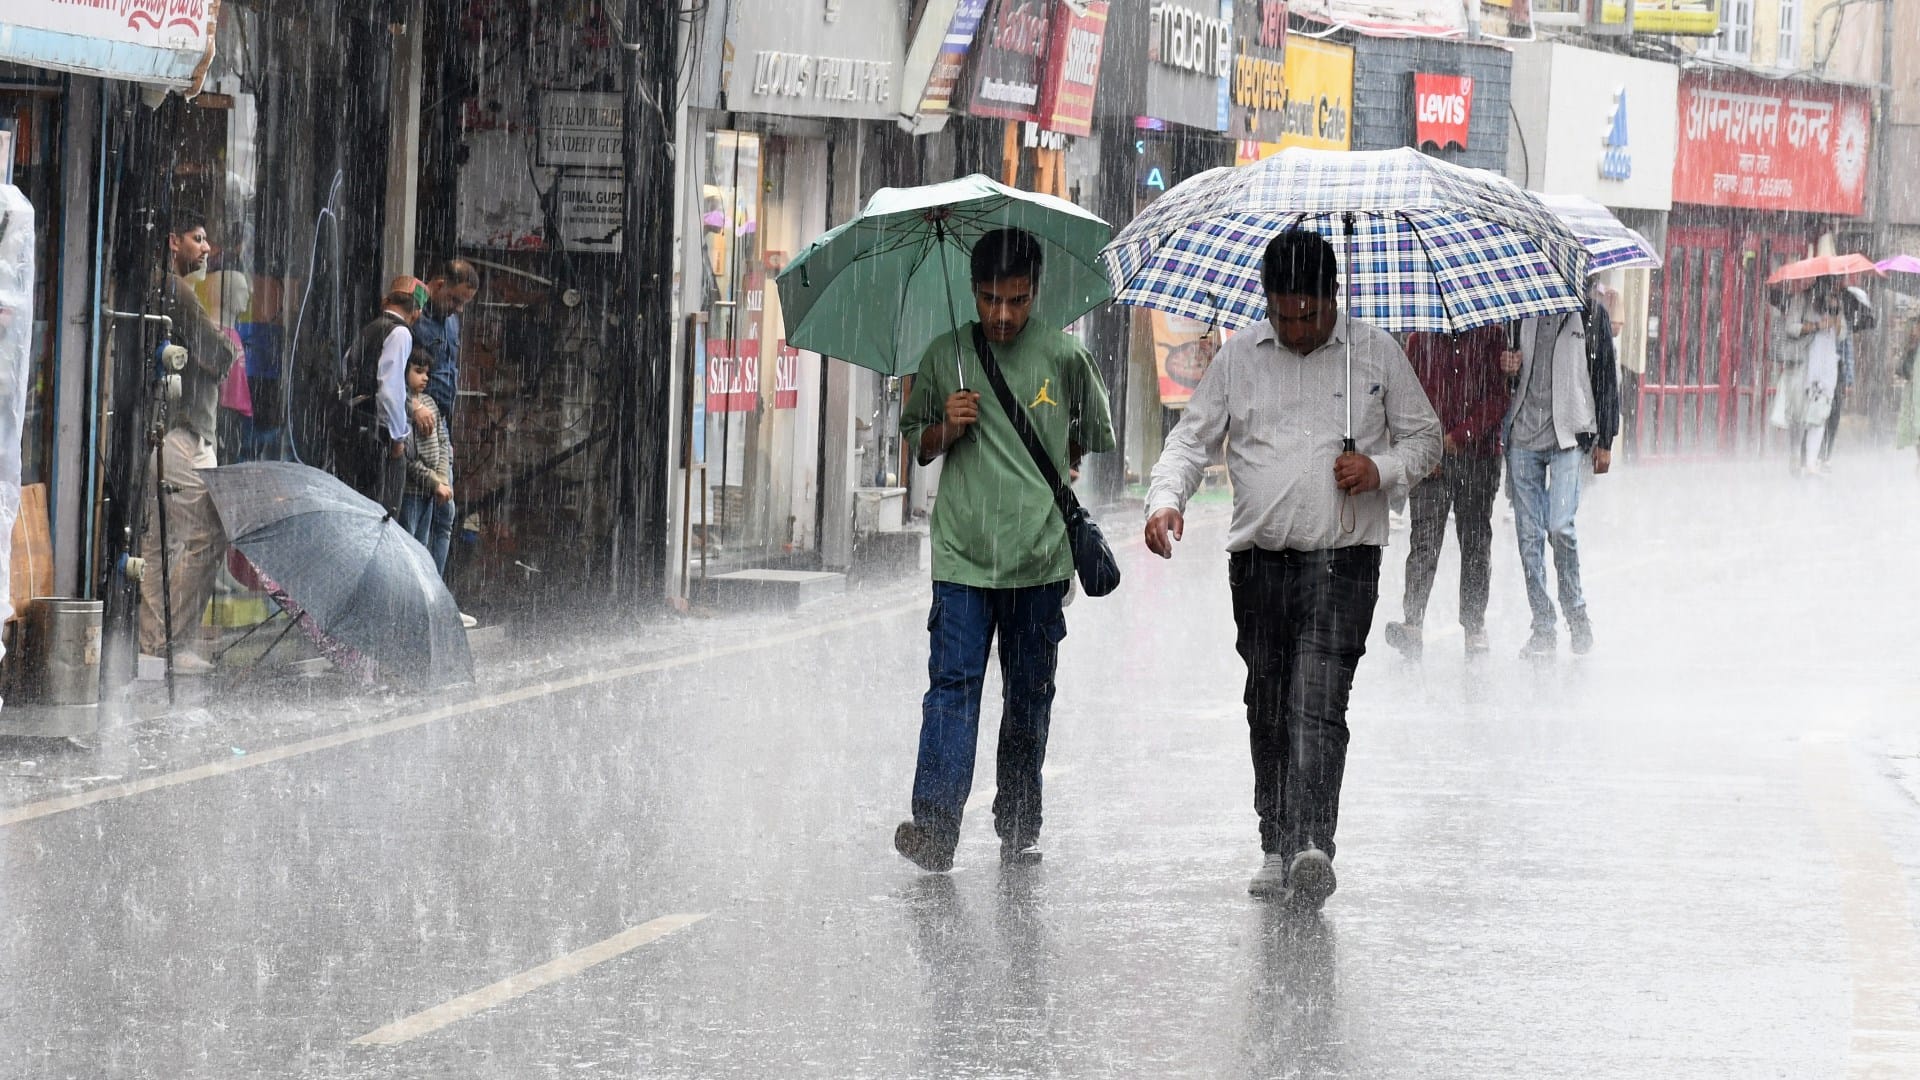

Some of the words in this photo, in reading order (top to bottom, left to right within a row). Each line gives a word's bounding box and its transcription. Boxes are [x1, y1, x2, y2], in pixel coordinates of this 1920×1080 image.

[753, 50, 811, 97] LOUIS
[814, 56, 892, 103] PHILIPPE
[547, 135, 595, 152] SANDEEP
[561, 191, 593, 204] BIMAL
